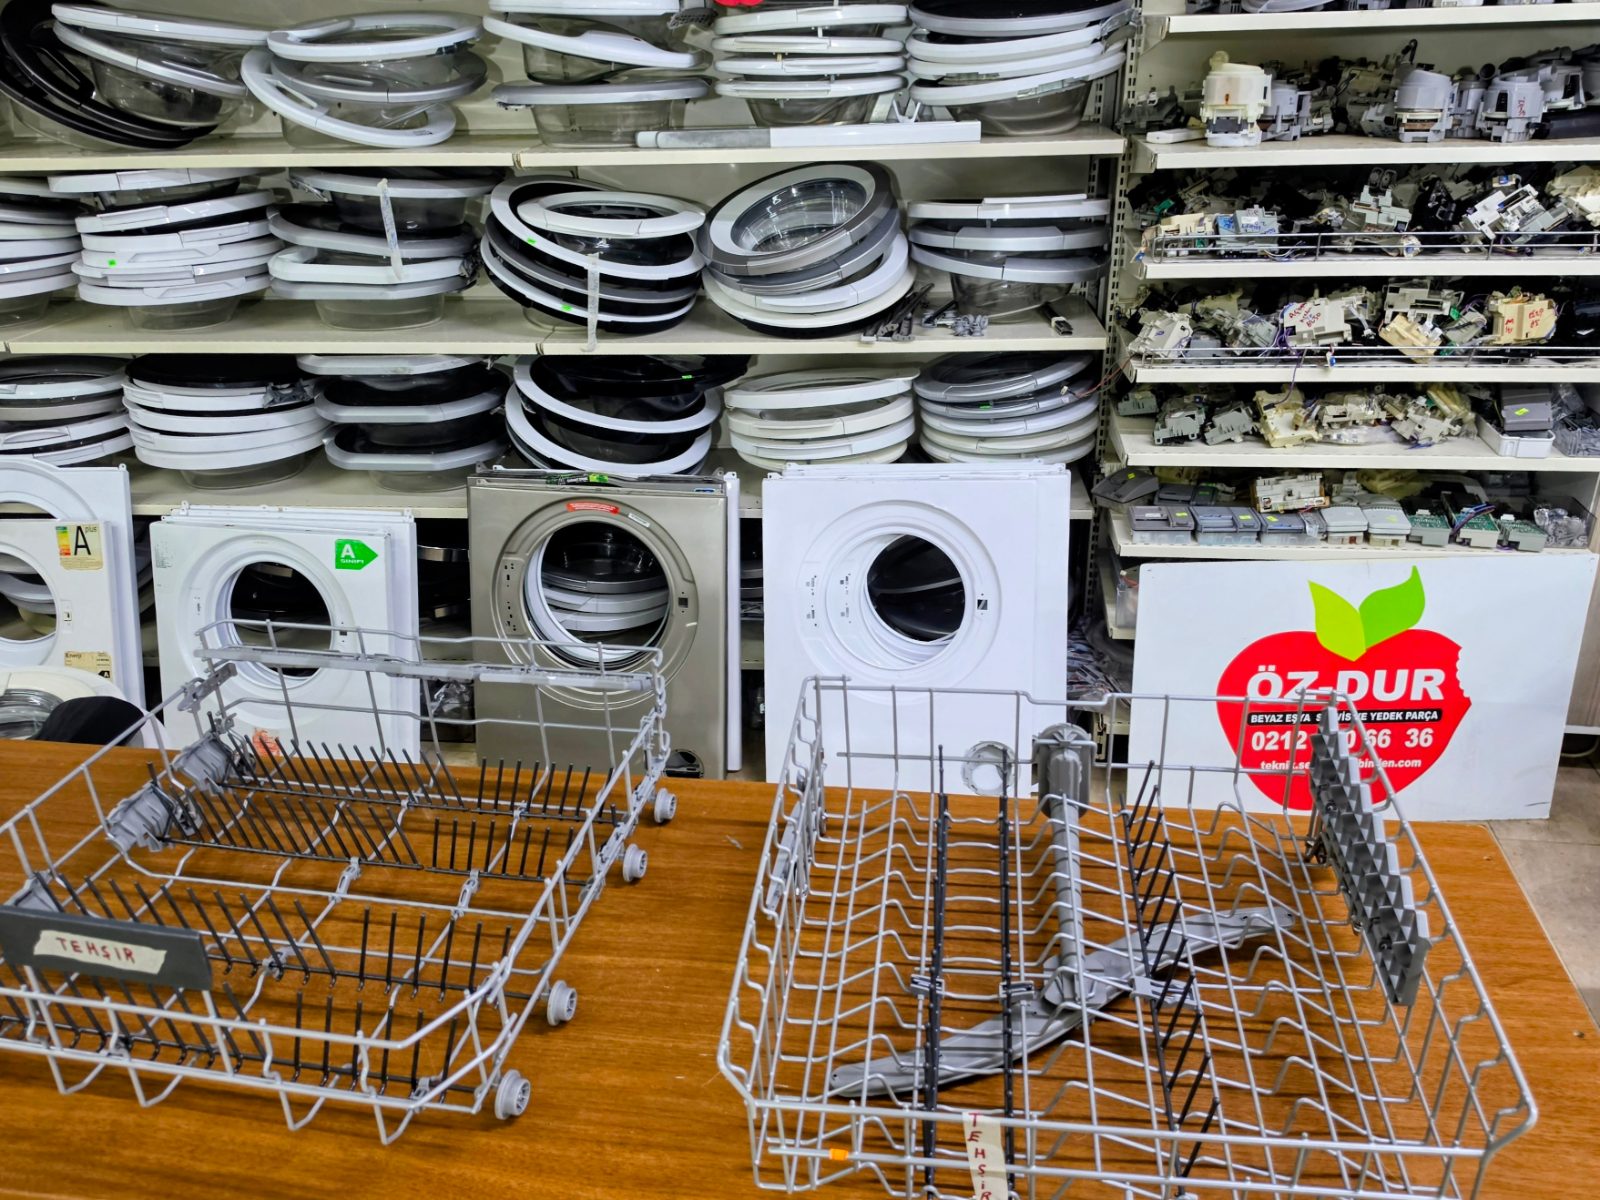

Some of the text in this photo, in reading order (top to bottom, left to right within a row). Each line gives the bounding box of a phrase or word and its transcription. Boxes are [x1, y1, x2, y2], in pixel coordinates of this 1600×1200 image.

[84, 526, 97, 534] plus
[73, 525, 92, 556] A
[340, 543, 356, 559] A
[1247, 664, 1446, 702] ÖZ-DUR
[1250, 713, 1284, 723] BEYAZ
[1315, 710, 1352, 723] SVİS
[1370, 711, 1404, 721] YEDEK
[1405, 710, 1439, 722] PARÇA
[1251, 730, 1308, 751] 0212
[1366, 728, 1392, 748] 66
[1405, 727, 1434, 748] 36
